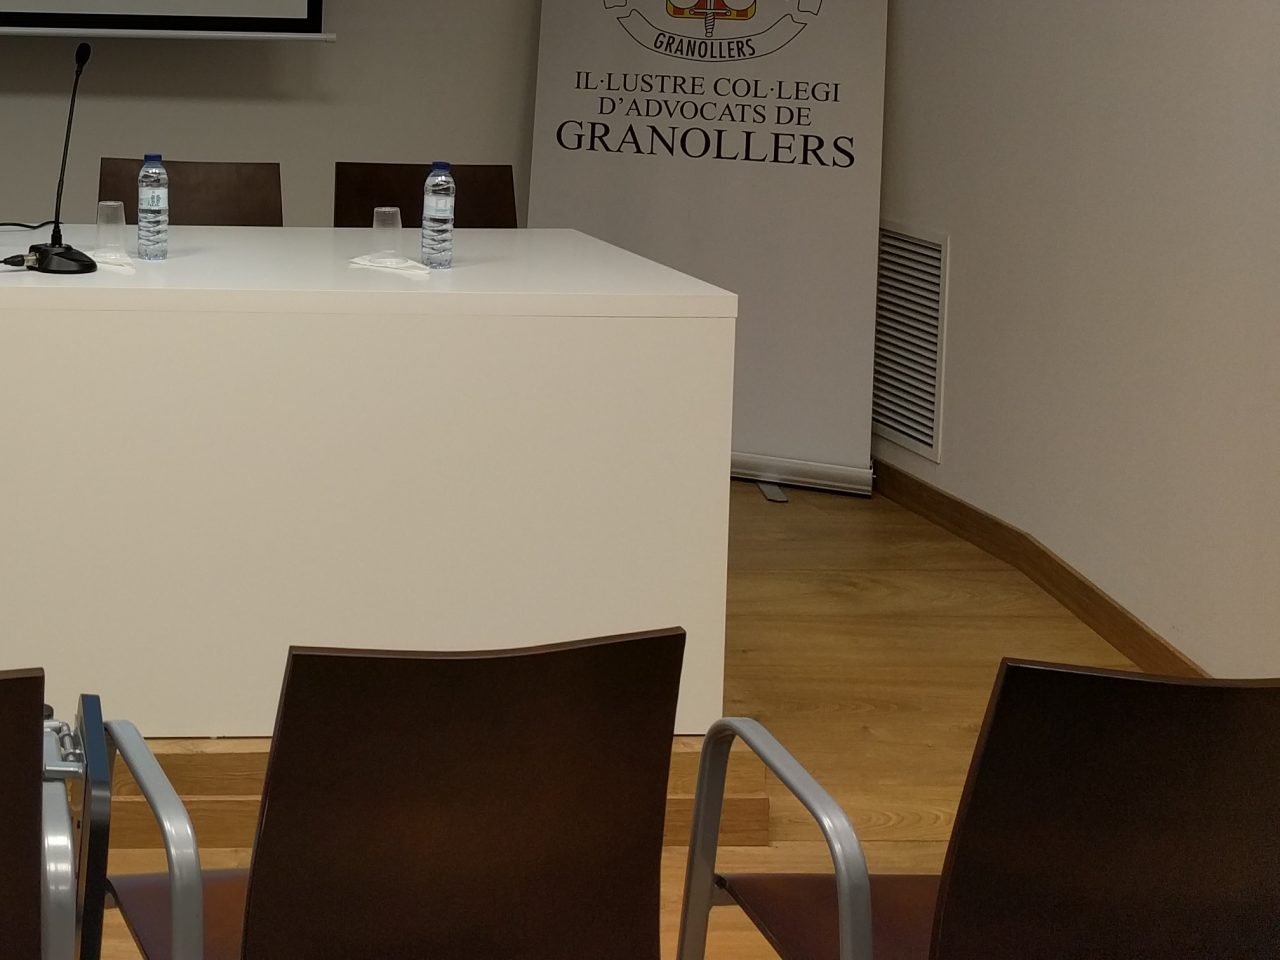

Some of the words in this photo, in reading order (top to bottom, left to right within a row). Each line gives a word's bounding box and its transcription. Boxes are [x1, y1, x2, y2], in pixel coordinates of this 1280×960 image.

[653, 32, 756, 59] GRANOLLERS
[575, 71, 705, 95] IL·LUSTRE
[713, 77, 841, 103] COL·LEGI
[598, 96, 766, 125] D'ADVOCATS
[775, 106, 812, 127] DE
[556, 119, 855, 168] GRANOLLERS
